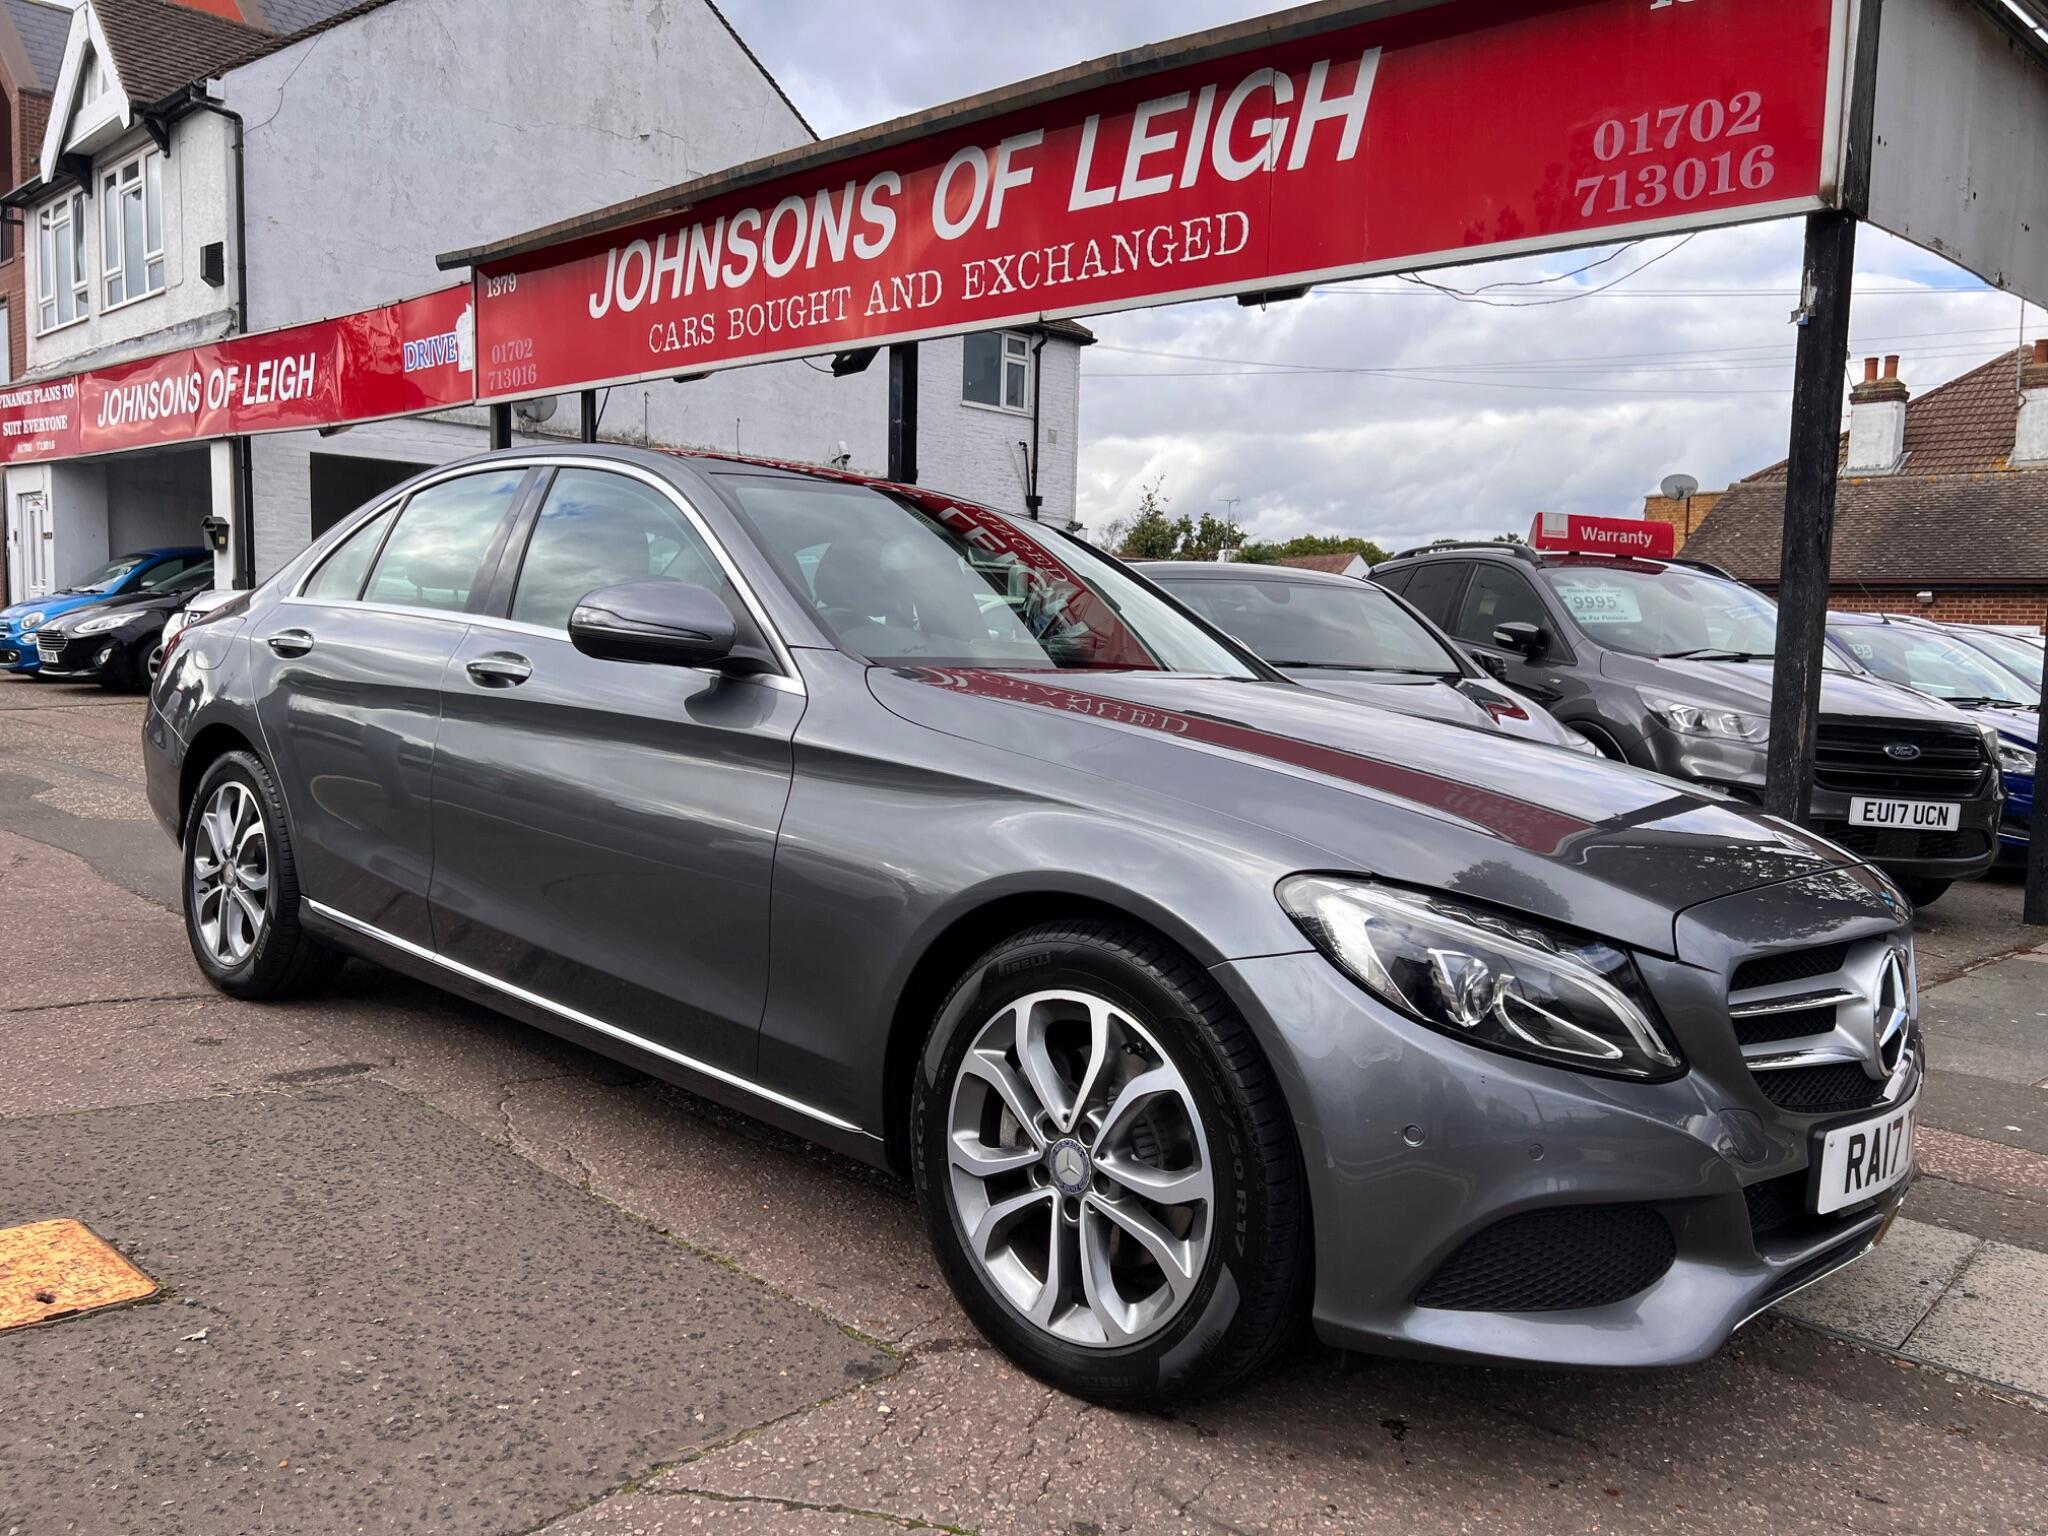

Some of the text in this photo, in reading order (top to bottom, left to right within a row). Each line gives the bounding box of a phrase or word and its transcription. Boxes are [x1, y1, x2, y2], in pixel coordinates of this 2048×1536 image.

[1593, 91, 1762, 162] 01702
[588, 47, 1382, 319] JOHNSONS OF LEIGH
[1574, 145, 1775, 217] 713016
[487, 273, 516, 297] 1379
[649, 211, 1250, 352] CARS BOUGHT AND EXCHANGED
[404, 332, 458, 373] DRIVE
[491, 338, 533, 364] 01702
[97, 352, 316, 427] JOHNSONS OF LEIGH
[488, 364, 537, 390] 713016
[0, 383, 75, 408] INANCE PLANS TO
[2, 415, 68, 436] SUIT EVERYONE
[1580, 526, 1653, 548] Warranty
[1573, 596, 1617, 609] 9995
[1863, 802, 1949, 826] EU17 UCN
[1844, 1116, 1904, 1194] RA17
